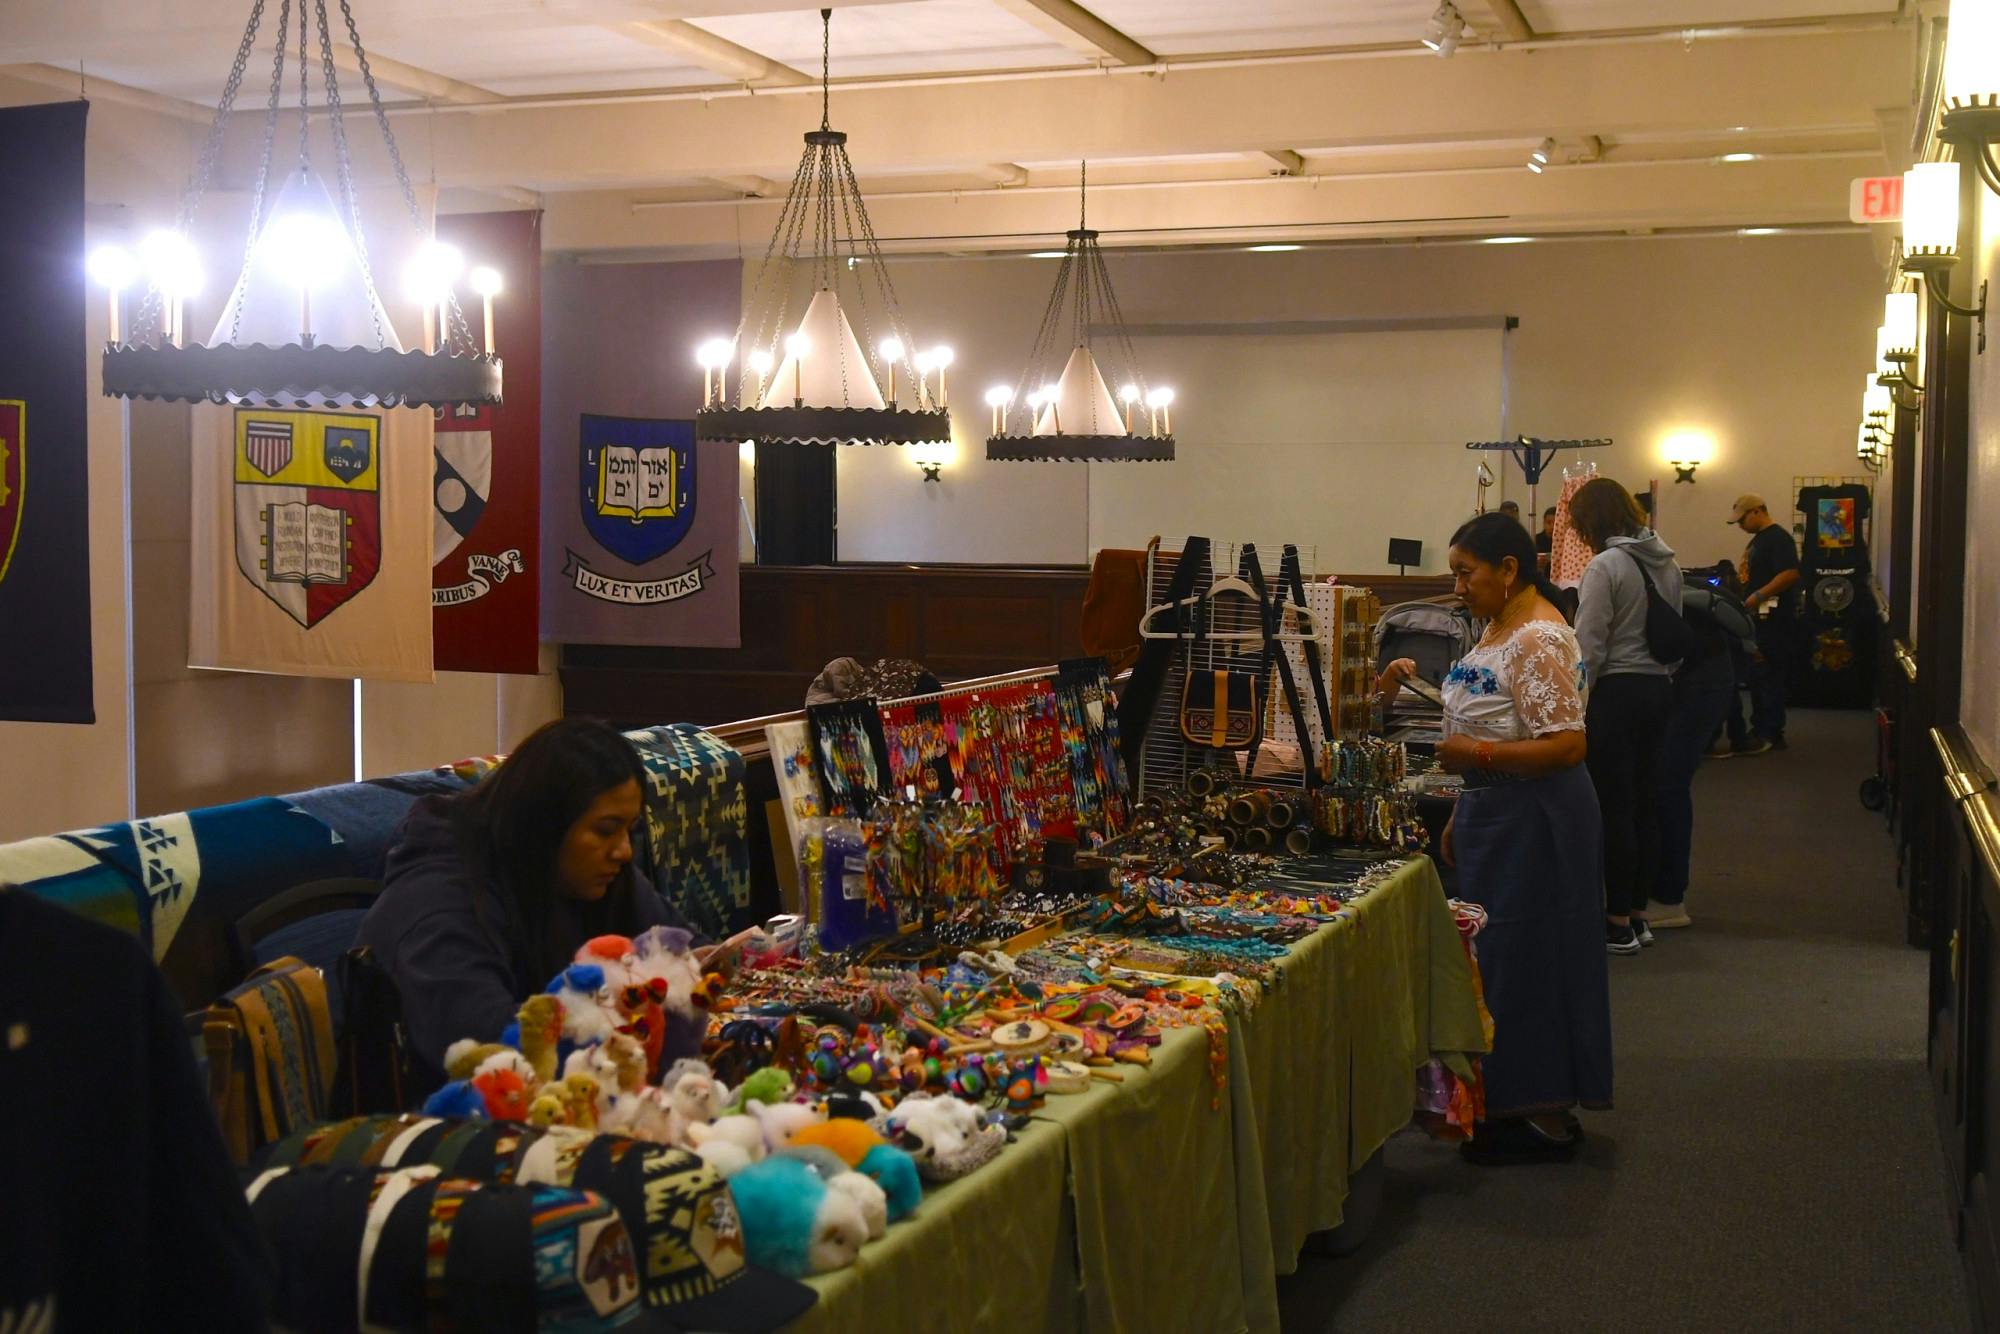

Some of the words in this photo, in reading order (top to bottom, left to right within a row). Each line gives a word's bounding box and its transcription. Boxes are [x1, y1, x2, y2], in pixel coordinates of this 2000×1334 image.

[1863, 178, 1903, 217] EXI
[432, 584, 476, 602] RIBUS
[471, 556, 508, 577] VANAE
[580, 572, 609, 594] LUX
[611, 584, 632, 598] ET
[634, 574, 698, 601] VERITAS
